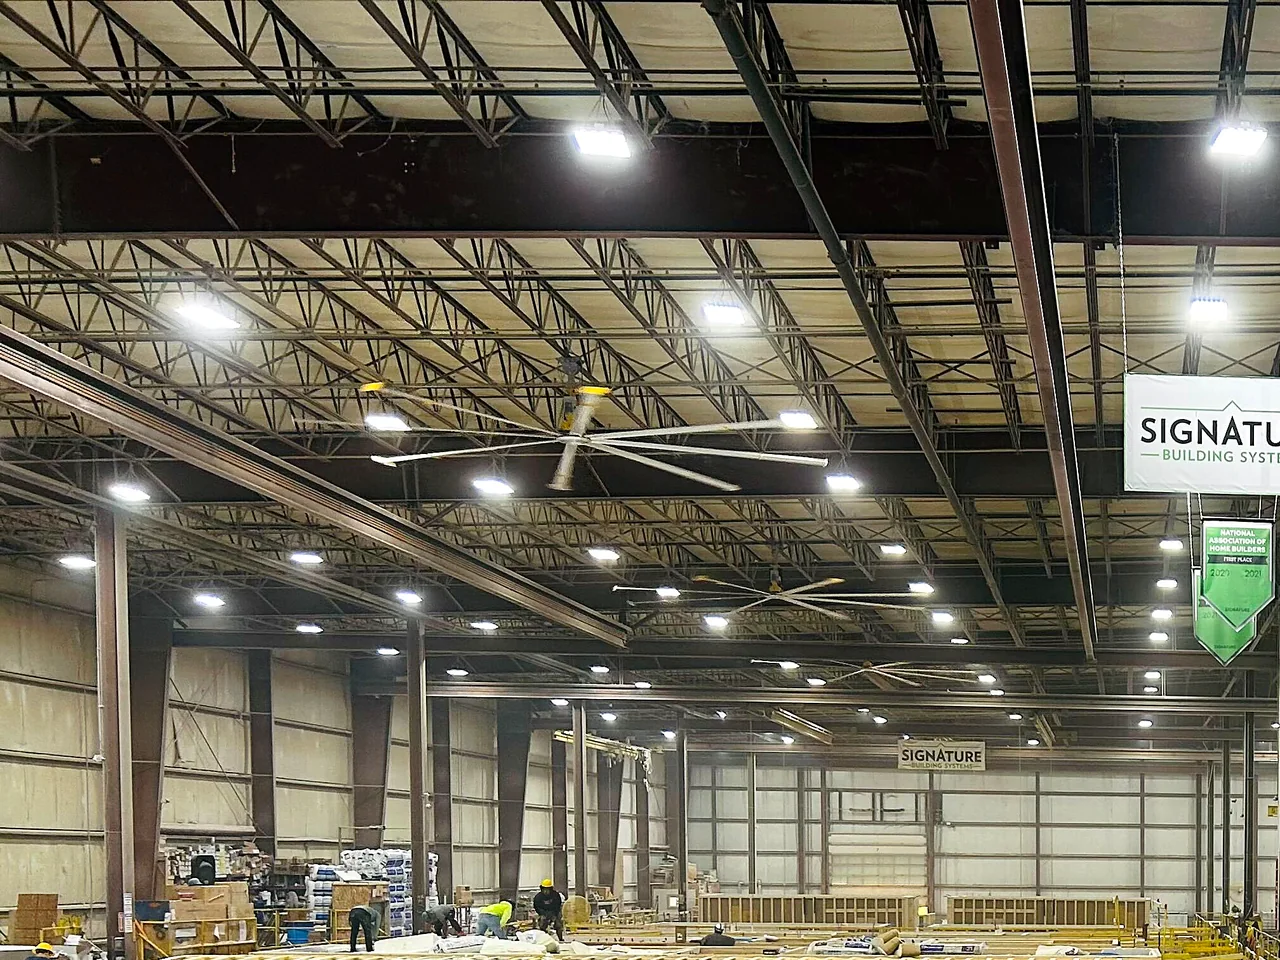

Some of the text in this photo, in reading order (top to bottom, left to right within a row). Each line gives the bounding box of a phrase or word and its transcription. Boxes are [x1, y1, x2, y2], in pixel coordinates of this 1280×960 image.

[1162, 449, 1235, 463] BUILDING
[1220, 529, 1256, 537] NATIONAL
[1208, 537, 1256, 545] ASSOCIATION
[1231, 545, 1266, 553] BUILDERS
[1245, 569, 1262, 578] 2021
[901, 748, 982, 762] SIGNATURE
